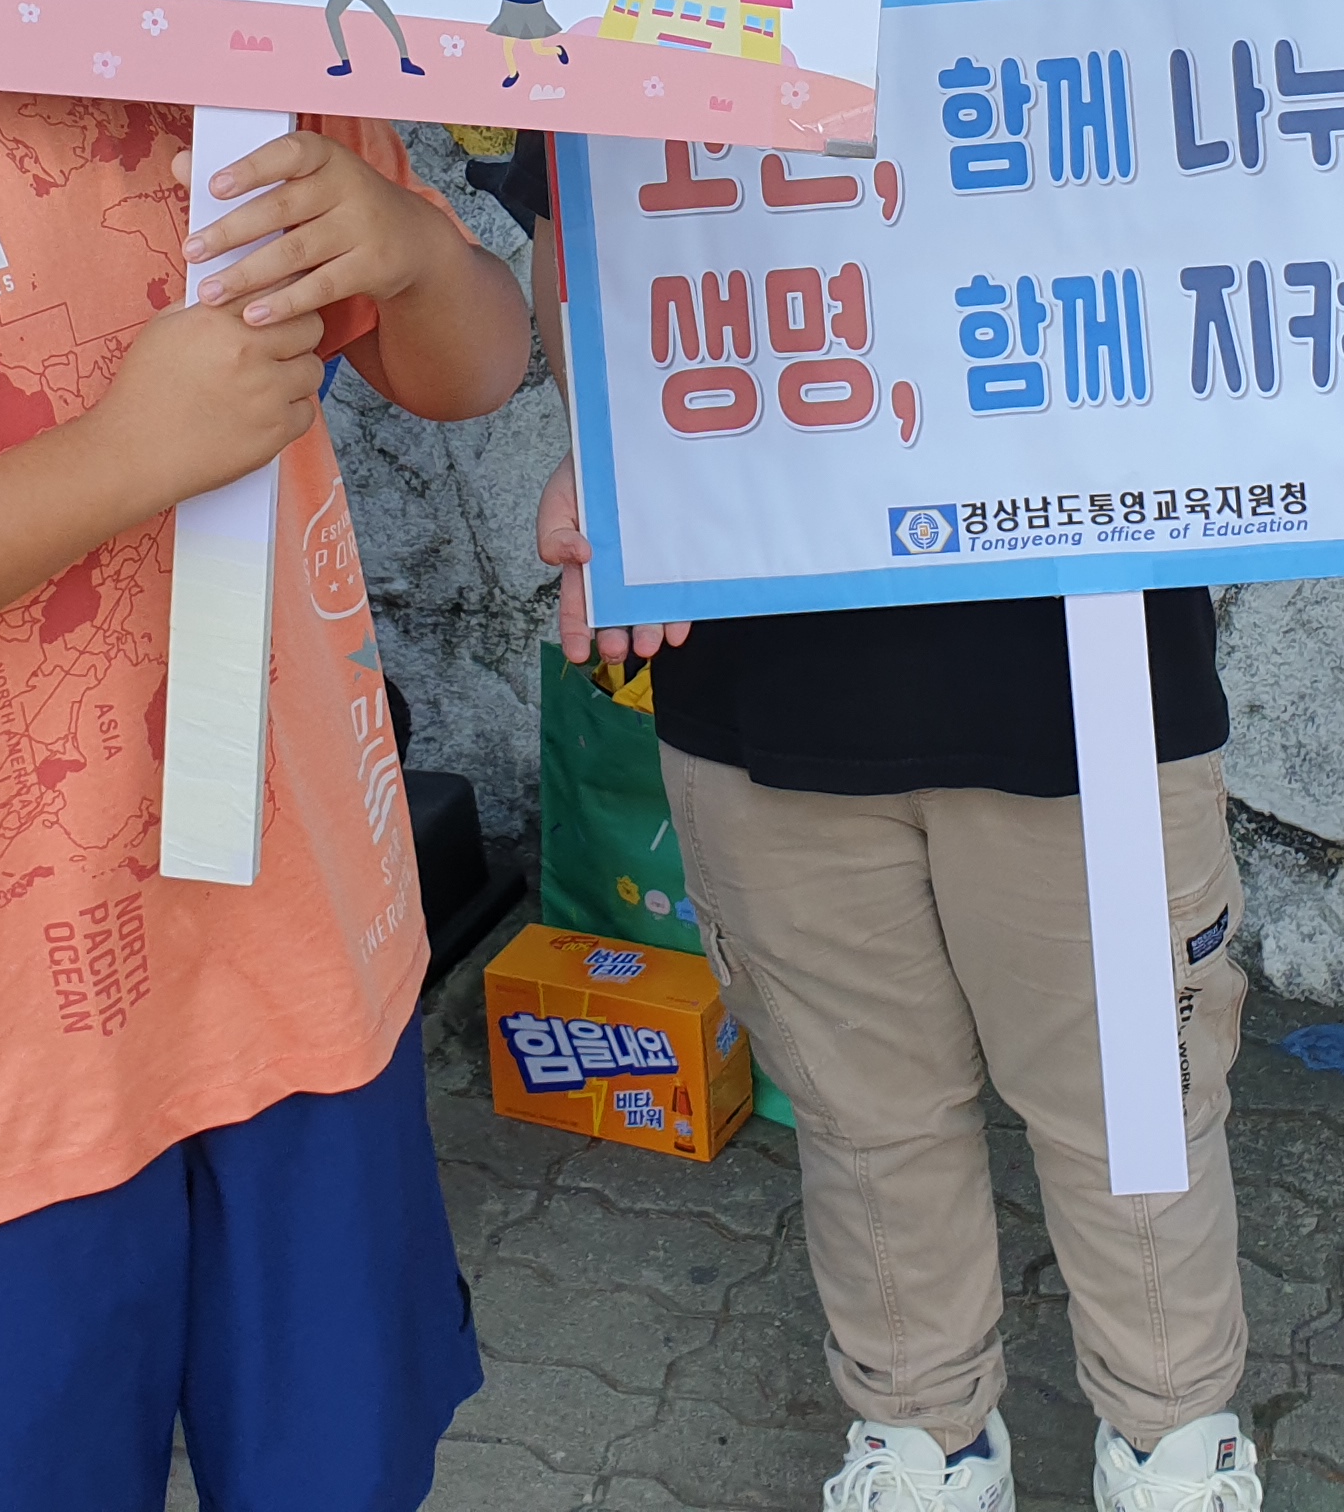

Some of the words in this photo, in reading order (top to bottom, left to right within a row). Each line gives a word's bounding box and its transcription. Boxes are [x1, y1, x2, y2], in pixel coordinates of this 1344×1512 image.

[937, 48, 1137, 196] 함께
[651, 261, 921, 447] 생명,
[956, 267, 1153, 418] 함께
[961, 482, 1309, 535] 경상남도통영교육지원청
[968, 530, 1083, 553] Tongyeong
[1096, 526, 1156, 543] office
[1169, 524, 1191, 540] of
[1203, 517, 1309, 538] Education
[94, 704, 123, 761] ASIA
[44, 921, 94, 1033] OCEAN
[79, 900, 127, 1037] PACIFIC
[114, 891, 151, 1007] NORTH
[615, 1091, 652, 1111] 비타
[626, 1107, 664, 1129] 파워
